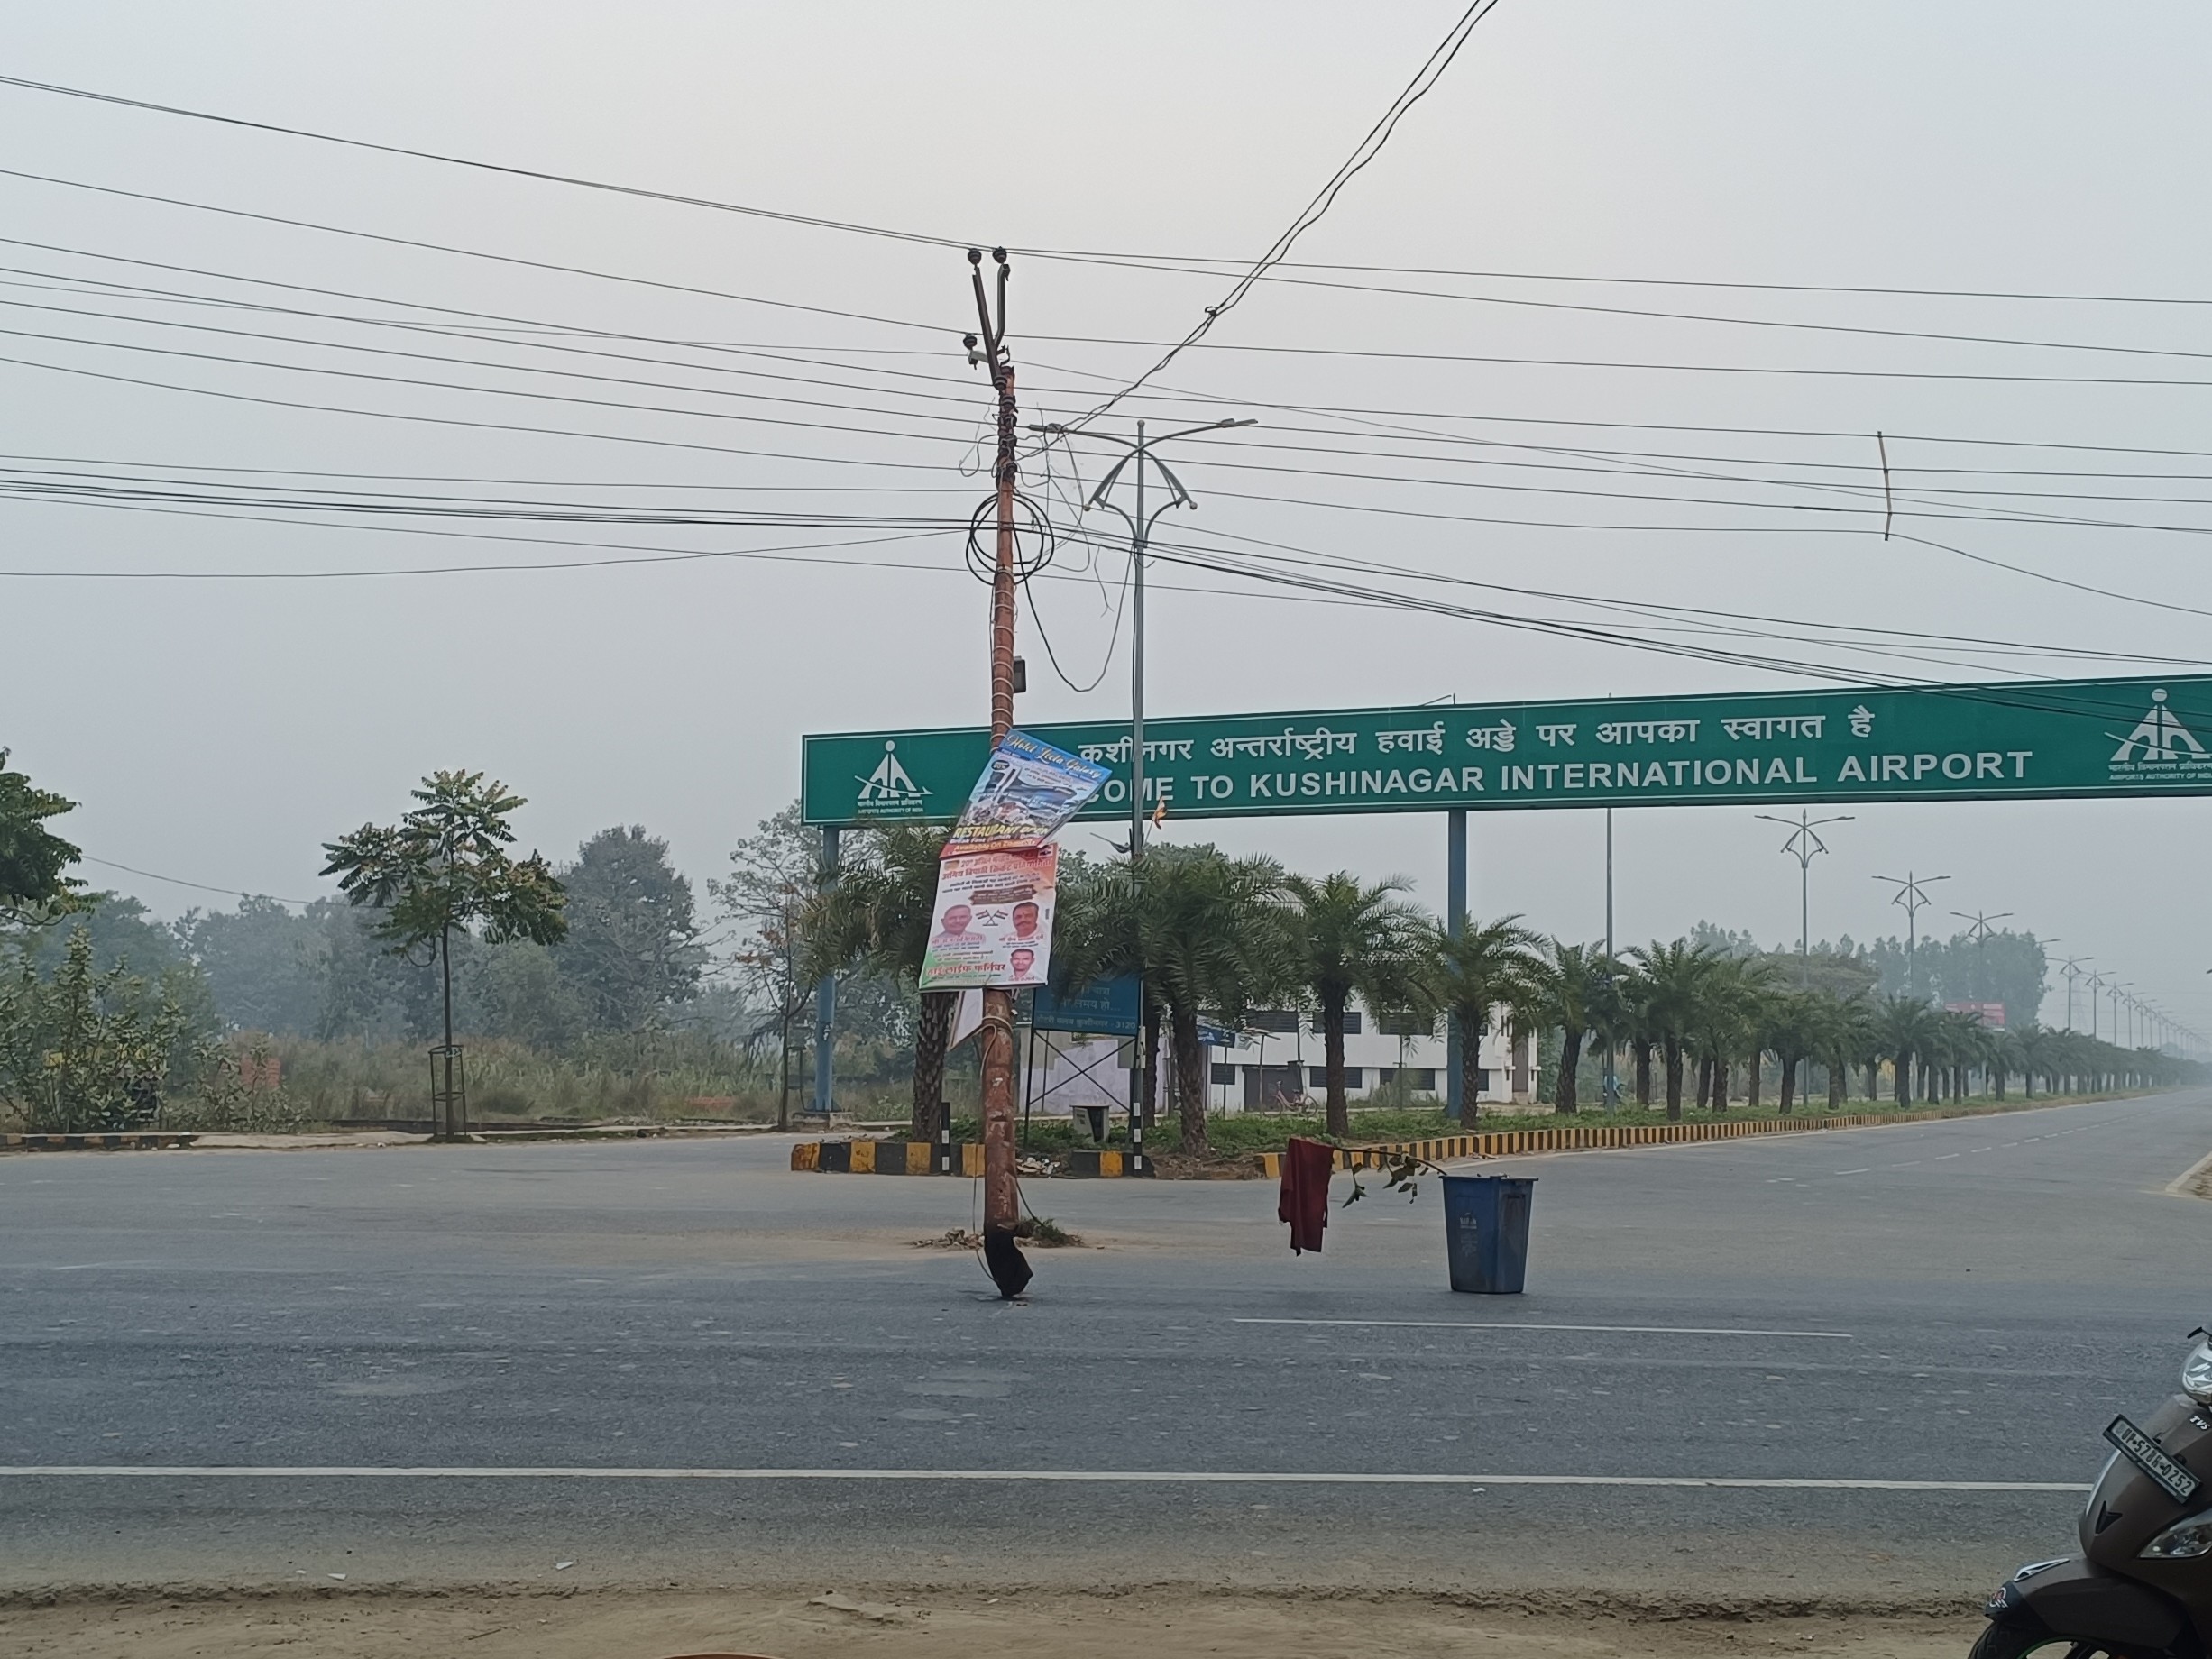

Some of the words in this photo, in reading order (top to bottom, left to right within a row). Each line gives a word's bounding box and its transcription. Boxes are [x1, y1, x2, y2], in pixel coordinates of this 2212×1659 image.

[1375, 721, 1445, 755] हवाई
[1466, 719, 1516, 752] अड्डे
[1536, 723, 1577, 747] पर
[1595, 720, 1700, 745] आपका
[1721, 715, 1826, 740] स्वागत
[1848, 705, 1875, 738] है
[1190, 775, 1234, 800] TO
[1250, 766, 1484, 798] KUSHINAGAR
[1501, 756, 1817, 791] INTERNATIONAL
[1837, 751, 2033, 783] AIRPORT
[953, 823, 1019, 839] RESTAURANT
[2189, 1415, 2210, 1430] TVS
